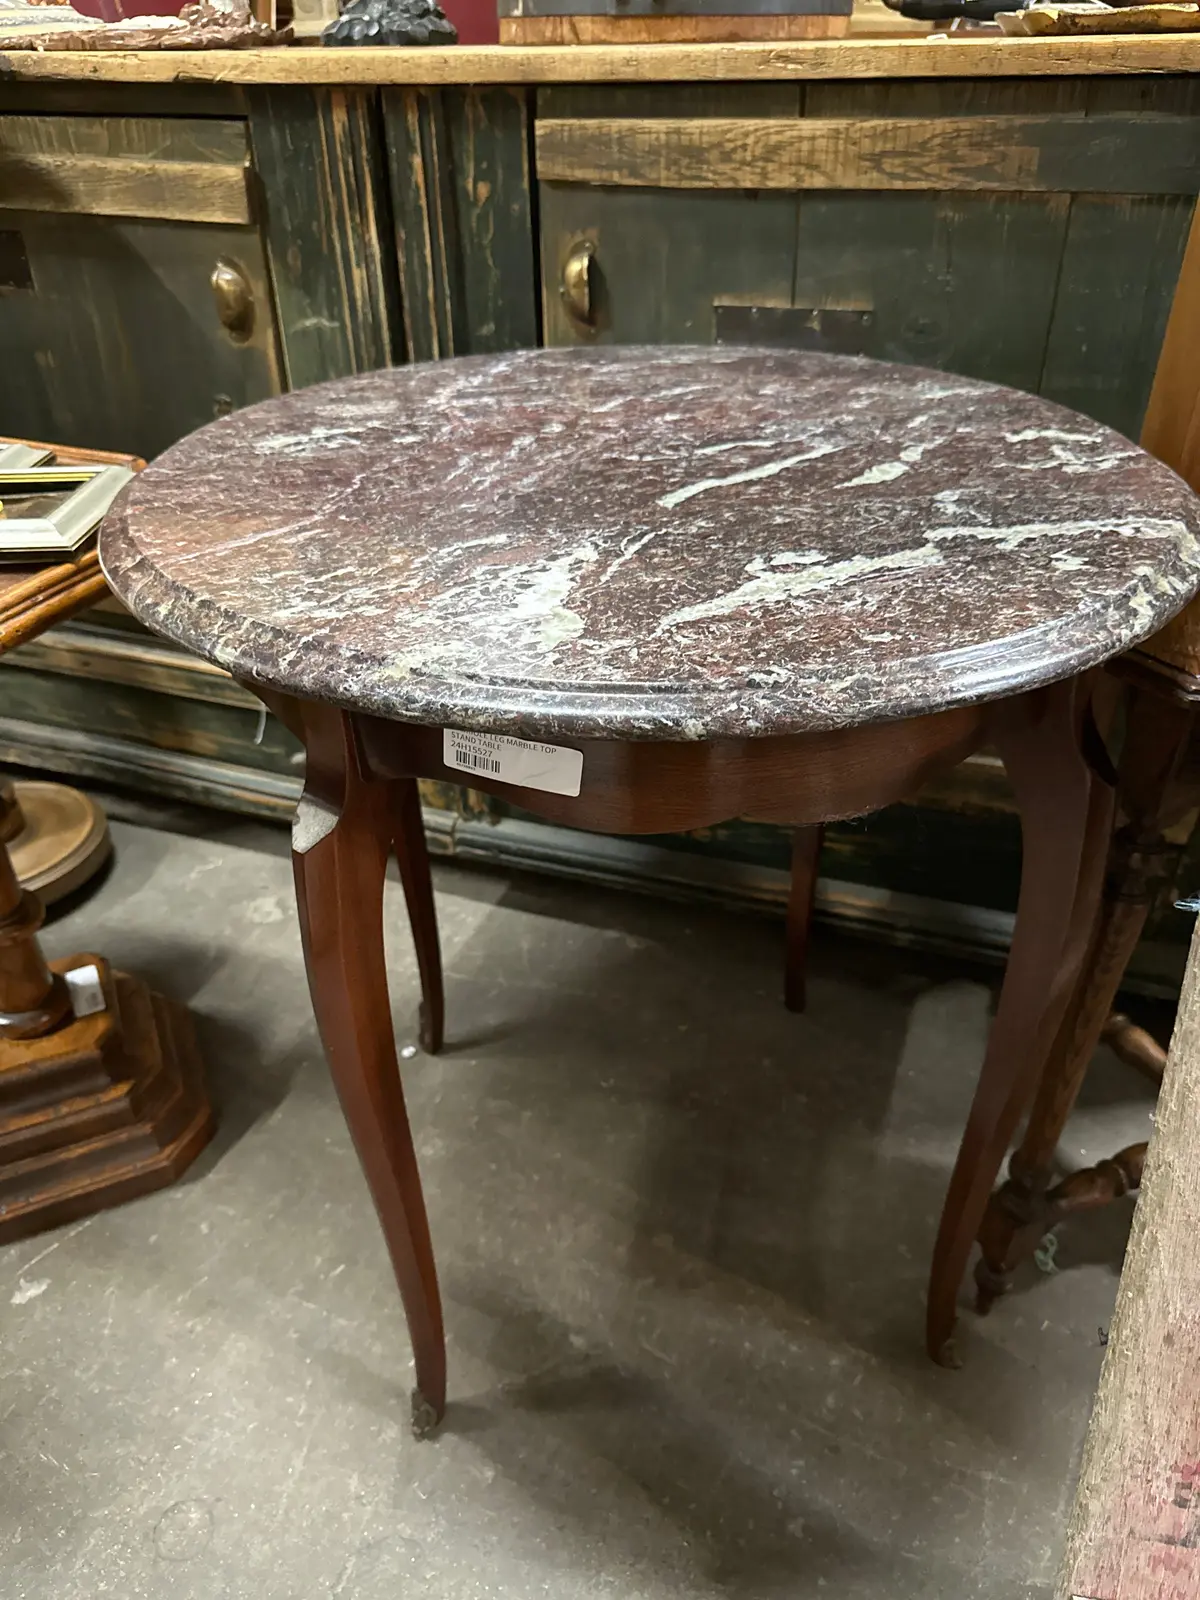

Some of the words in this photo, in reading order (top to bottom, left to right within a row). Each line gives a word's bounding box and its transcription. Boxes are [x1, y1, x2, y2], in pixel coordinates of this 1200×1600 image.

[450, 740, 493, 758] 24H15527
[451, 731, 477, 744] STAND
[478, 738, 502, 751] TABLE
[490, 733, 505, 744] LEG
[506, 738, 538, 752] MARBLE
[540, 745, 557, 755] TOP
